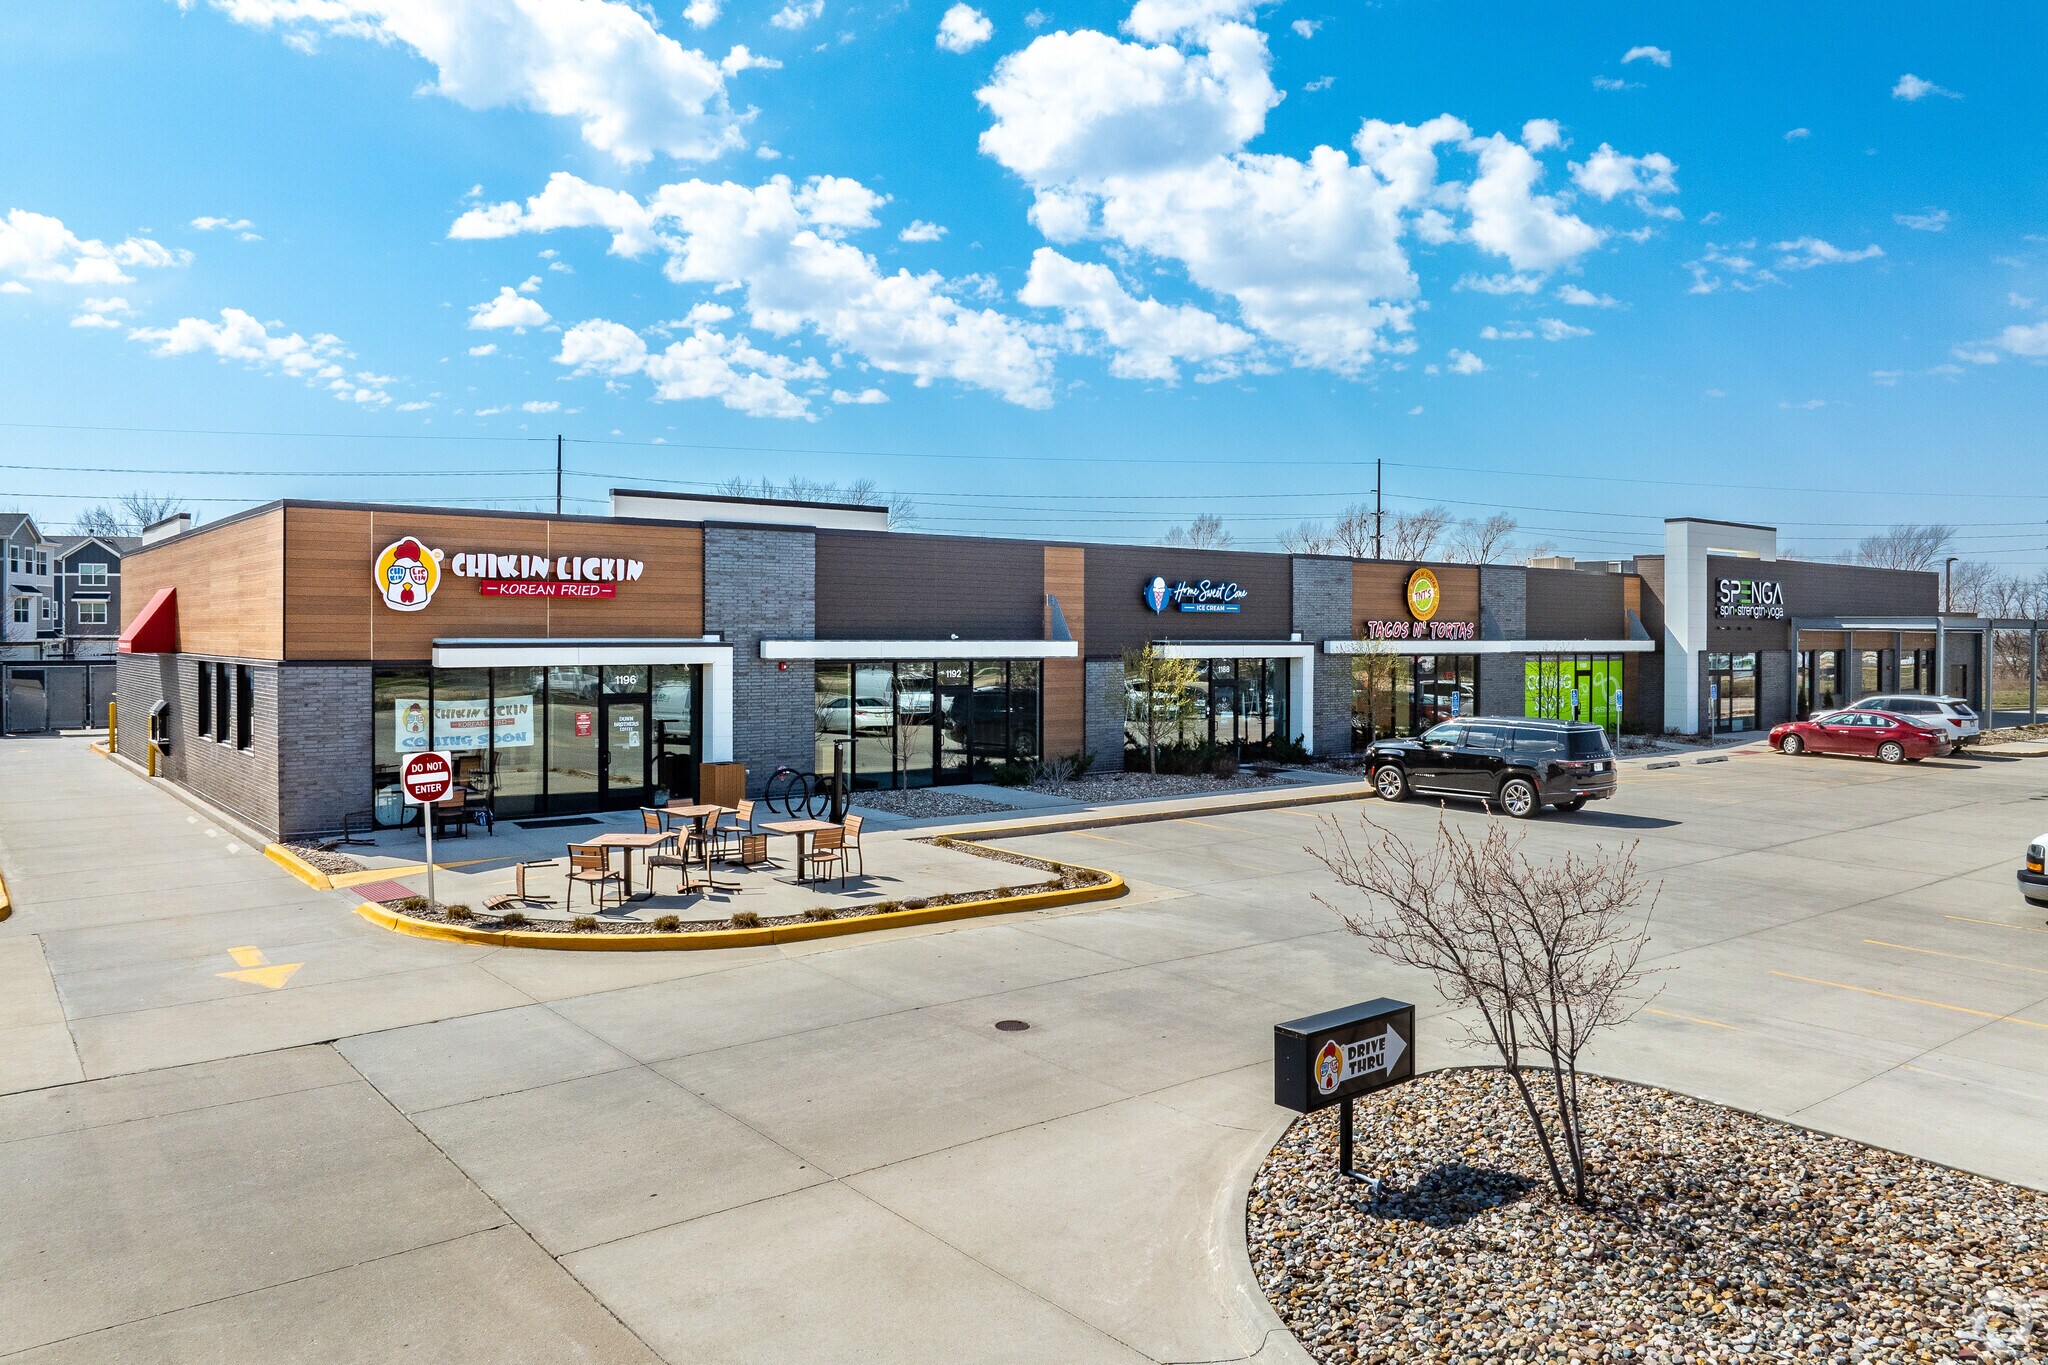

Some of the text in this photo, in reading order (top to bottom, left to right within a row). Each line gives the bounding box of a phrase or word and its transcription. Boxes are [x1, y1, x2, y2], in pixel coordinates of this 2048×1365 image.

[451, 552, 644, 582] CHIKIN LICKIN
[499, 584, 601, 596] KOREAN FRIED
[1174, 579, 1248, 602] Home Sweet Cone
[1415, 589, 1431, 601] TNT'S
[1720, 580, 1784, 605] SPENGA
[1368, 620, 1475, 641] TACOS N' TORTAS
[615, 675, 637, 685] 1196
[945, 669, 962, 679] 1192
[457, 720, 485, 729] KOREAN
[411, 761, 443, 773] DO NOT
[415, 783, 442, 795] ENTER
[1347, 1037, 1386, 1061] DRIVE
[1348, 1057, 1385, 1075] THRU
